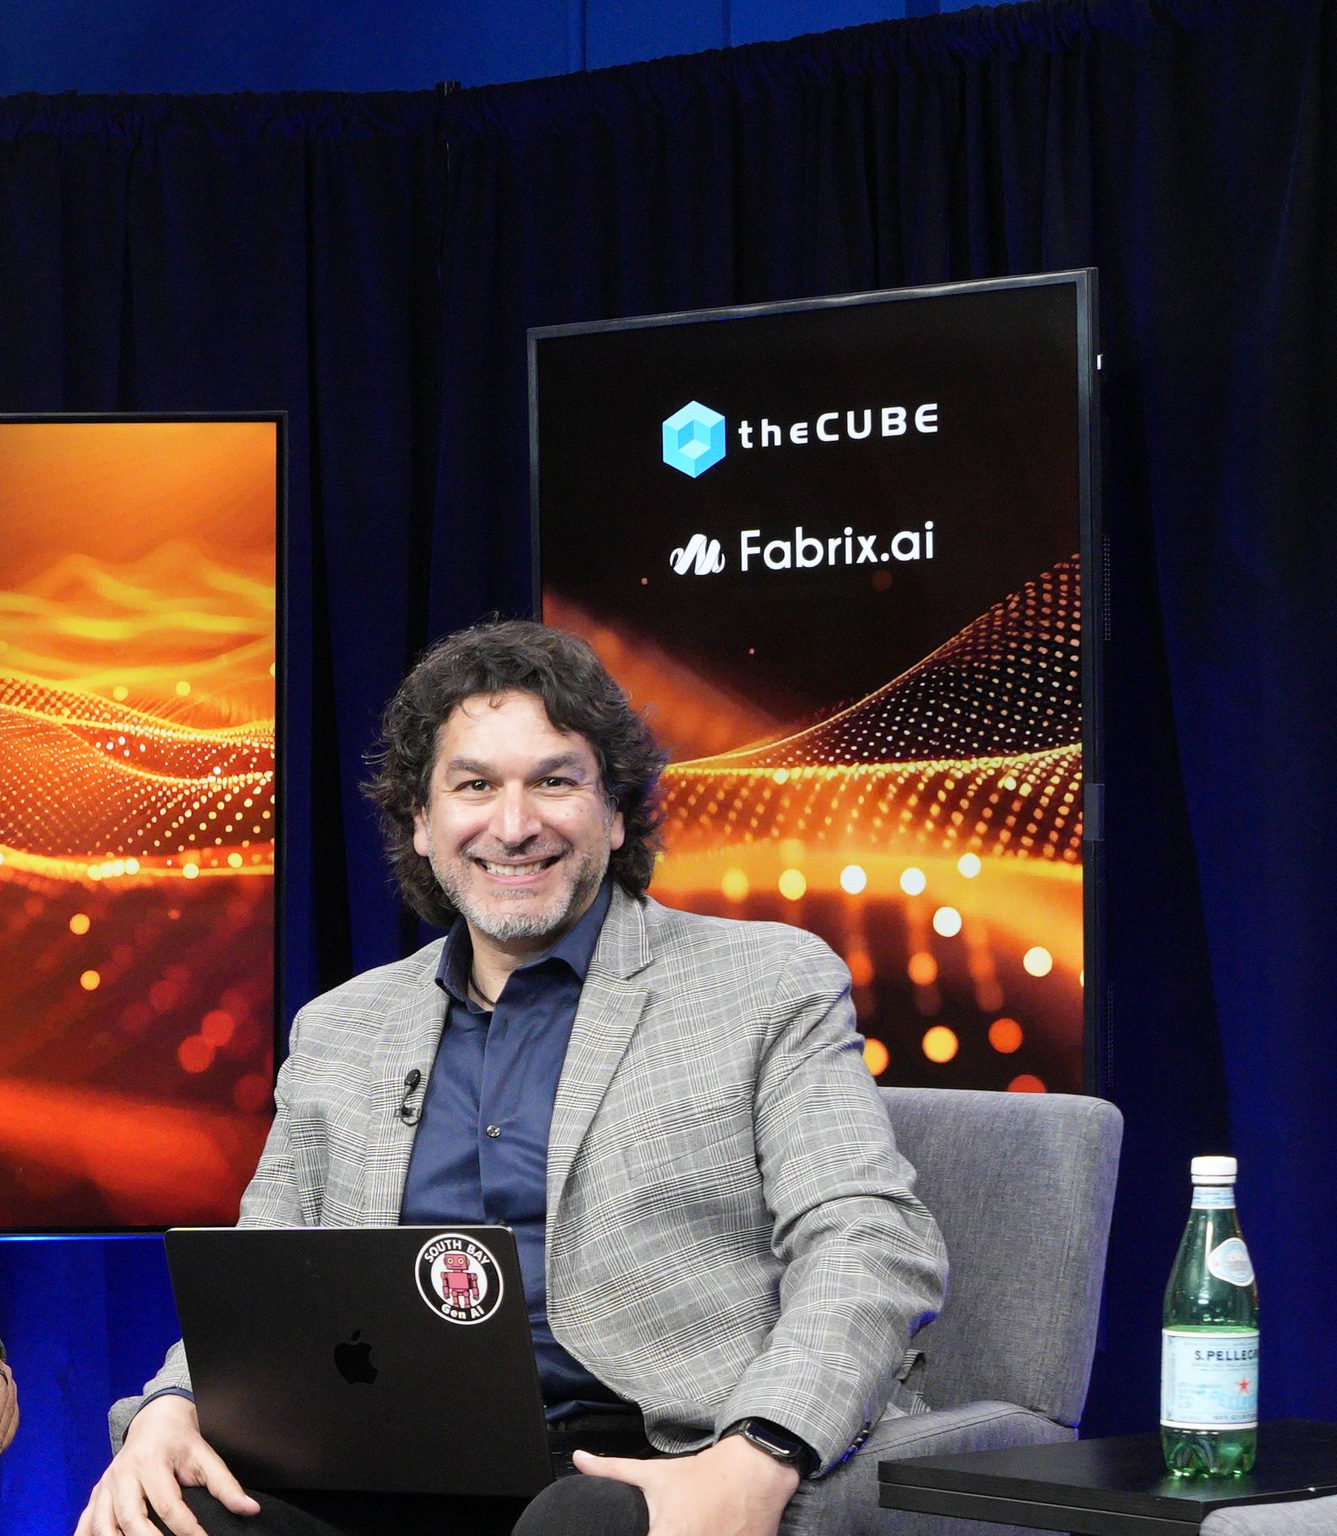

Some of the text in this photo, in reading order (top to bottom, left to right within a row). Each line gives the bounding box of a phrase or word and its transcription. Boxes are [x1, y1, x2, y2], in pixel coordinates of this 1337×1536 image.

[737, 402, 939, 449] theCUBE
[740, 520, 934, 572] Fabrix.ai
[424, 1239, 491, 1266] SOUTH BAY
[441, 1303, 485, 1320] Gen AI
